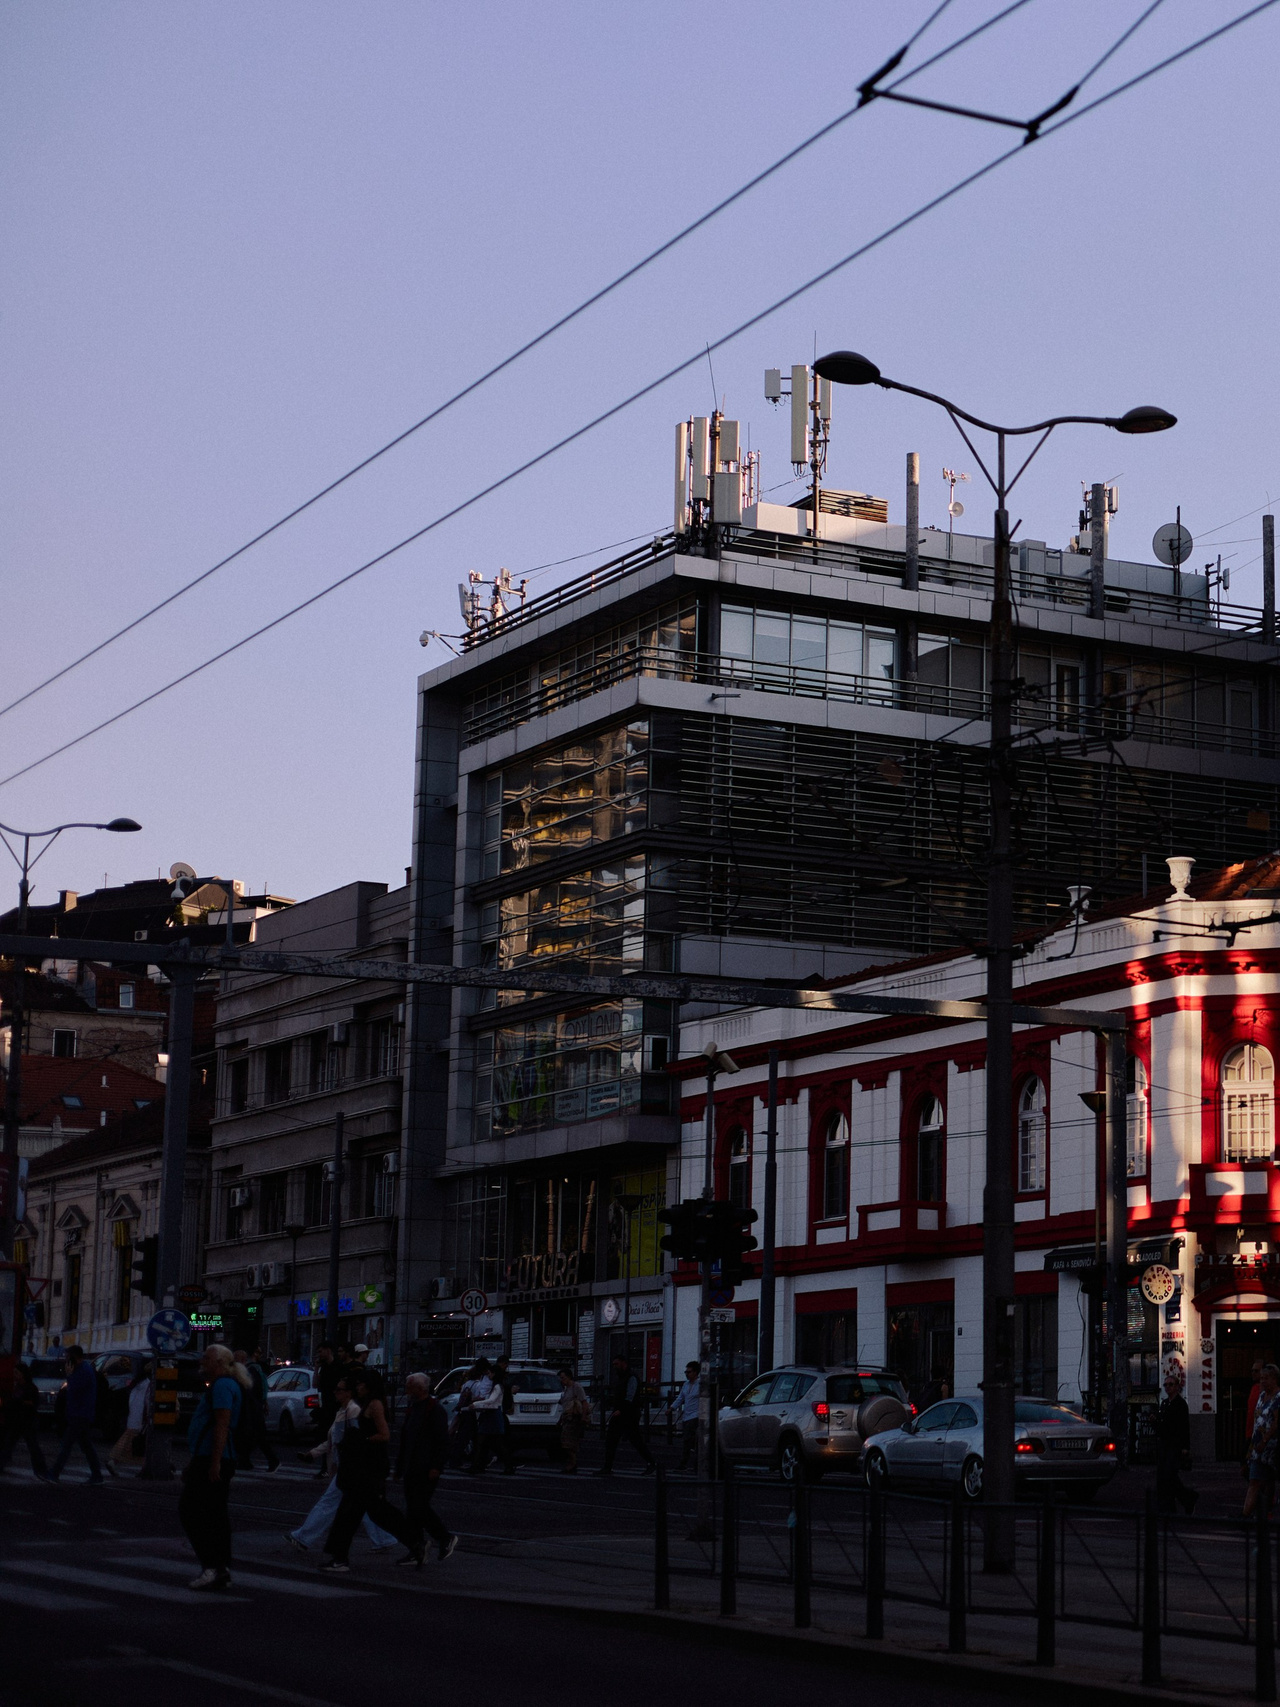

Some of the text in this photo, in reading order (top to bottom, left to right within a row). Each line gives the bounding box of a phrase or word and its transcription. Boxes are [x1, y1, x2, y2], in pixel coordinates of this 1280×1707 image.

[1136, 1251, 1162, 1263] SLADOLED
[180, 1290, 205, 1298] FOSSIL
[465, 1295, 482, 1310] 30
[1162, 1332, 1184, 1340] PIZZERIA
[1202, 1358, 1212, 1412] PIZZA
